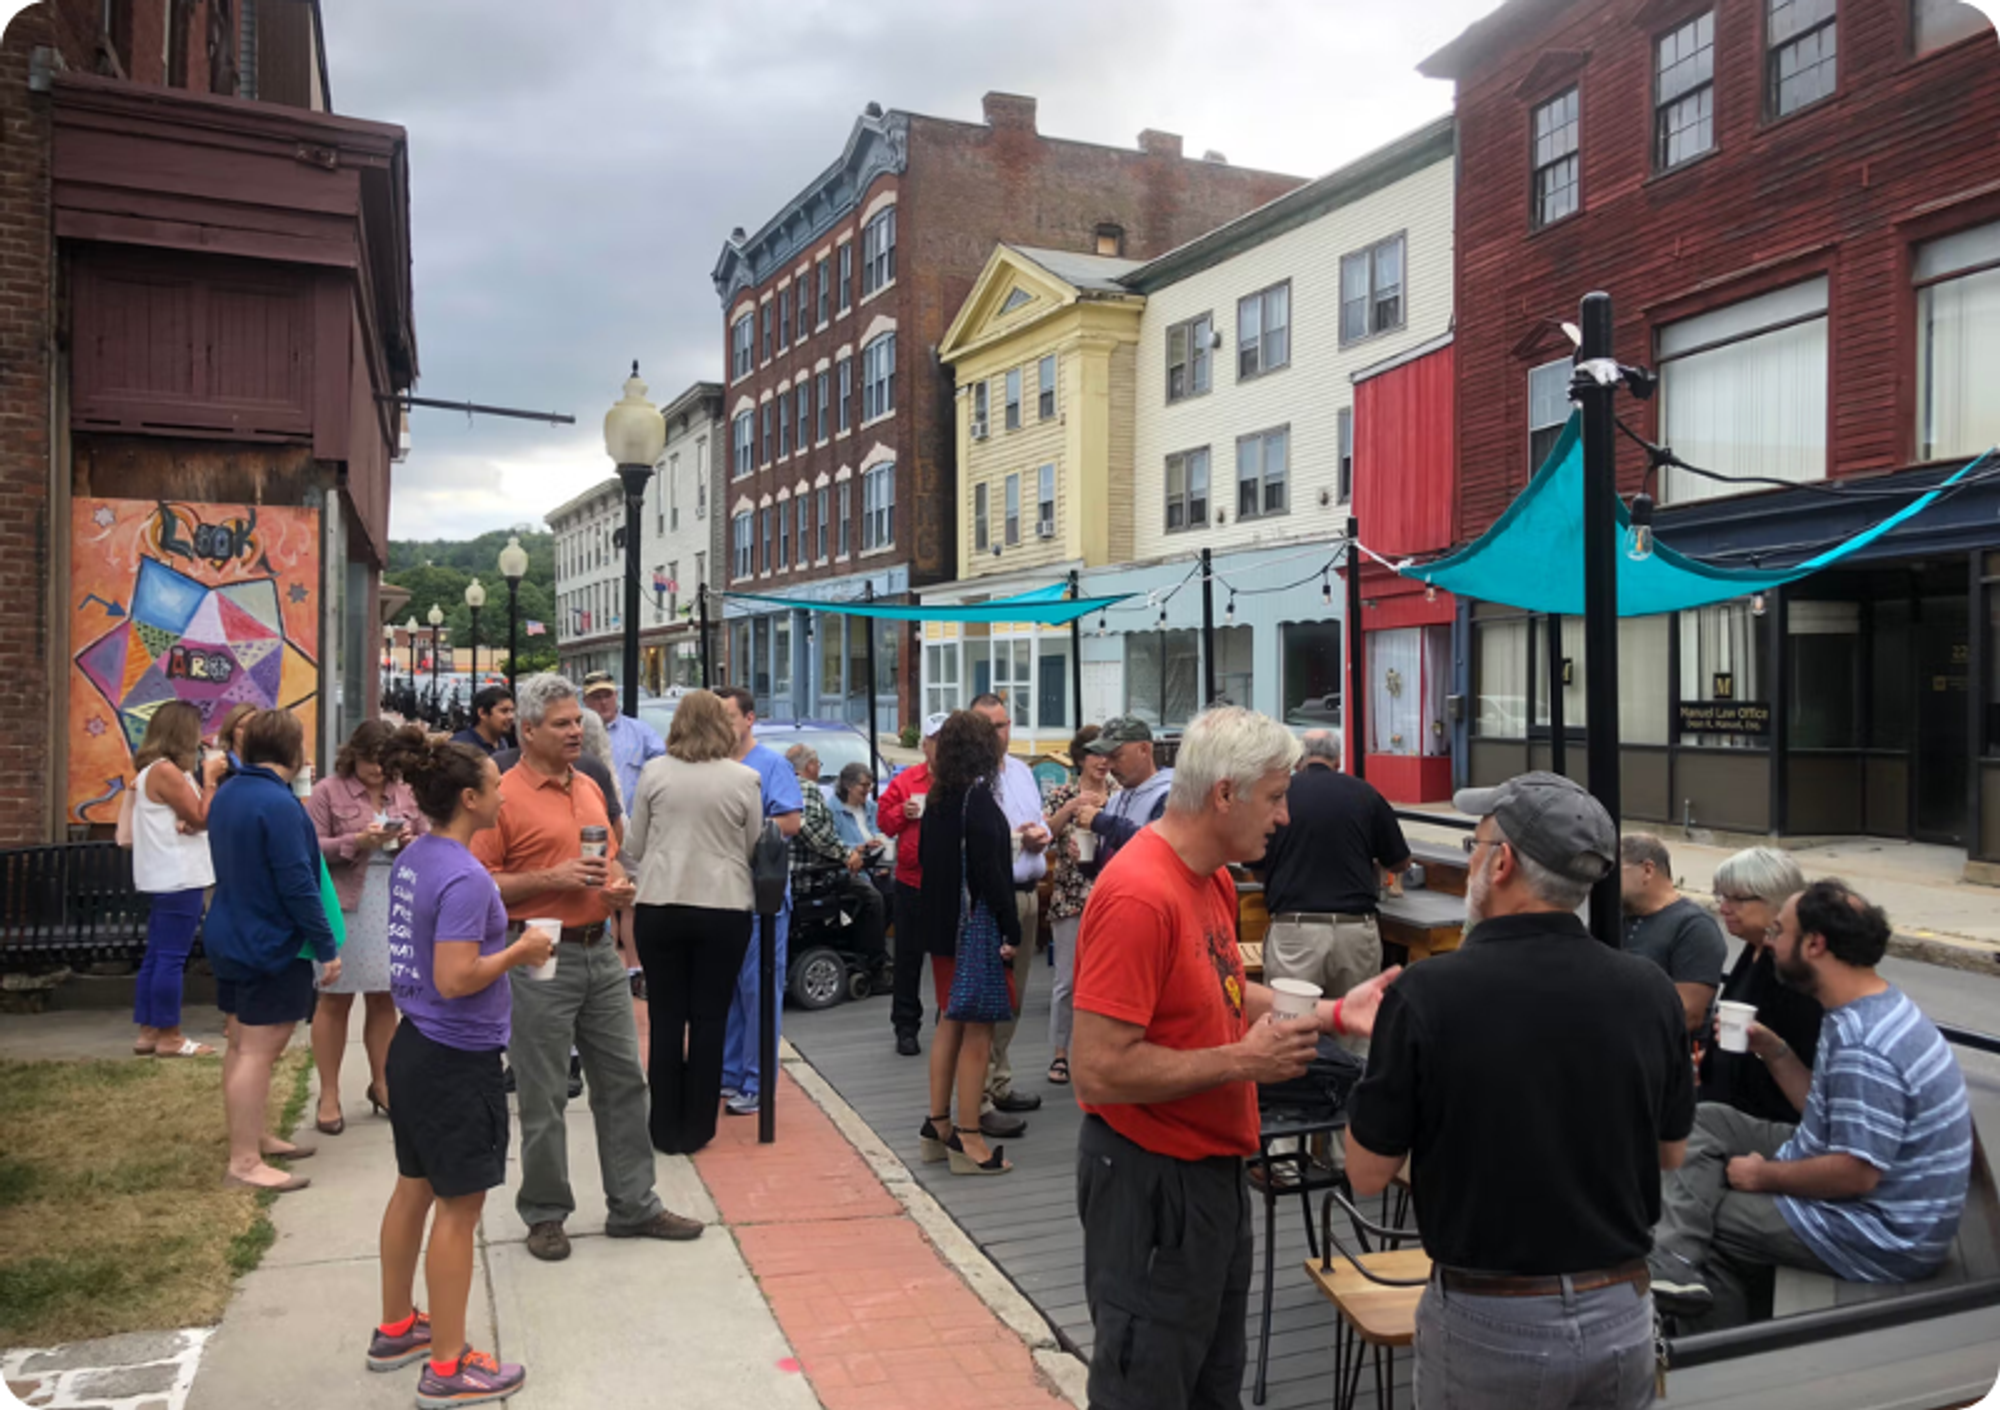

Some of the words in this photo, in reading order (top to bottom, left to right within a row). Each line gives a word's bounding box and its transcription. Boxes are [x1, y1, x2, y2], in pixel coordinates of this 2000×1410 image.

[1716, 677, 1732, 697] M
[1716, 707, 1736, 719] Law
[1737, 706, 1769, 719] Office
